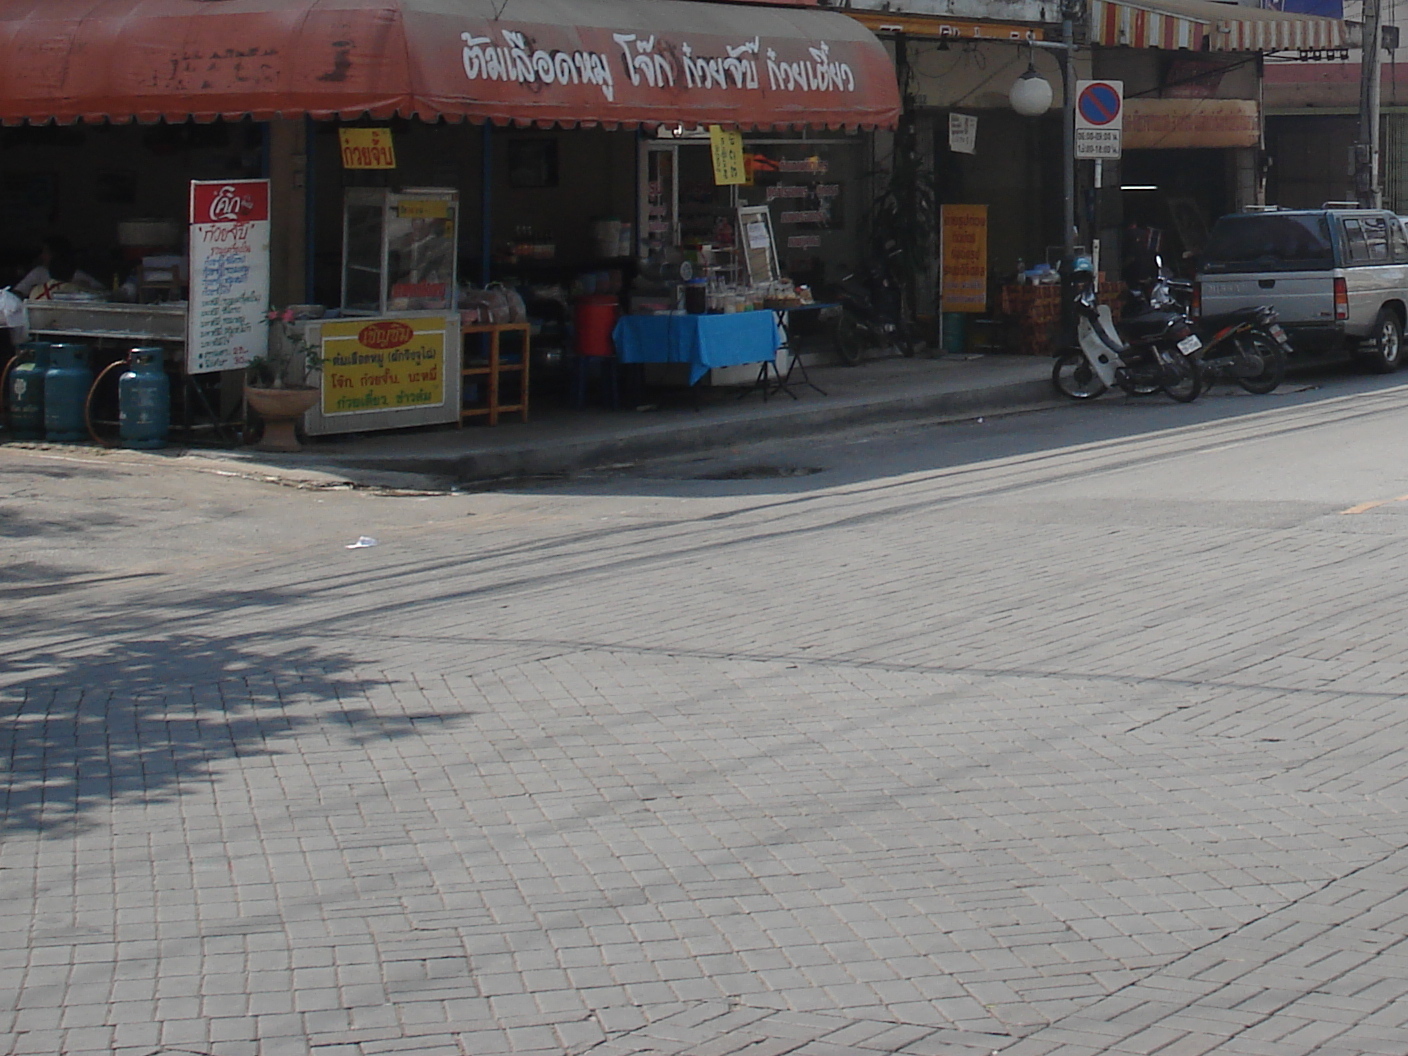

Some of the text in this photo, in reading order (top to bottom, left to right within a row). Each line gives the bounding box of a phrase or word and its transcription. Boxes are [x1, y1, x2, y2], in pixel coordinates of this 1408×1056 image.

[461, 29, 613, 101] ต้มเลือดหมู
[613, 33, 676, 88] โจ๊ก
